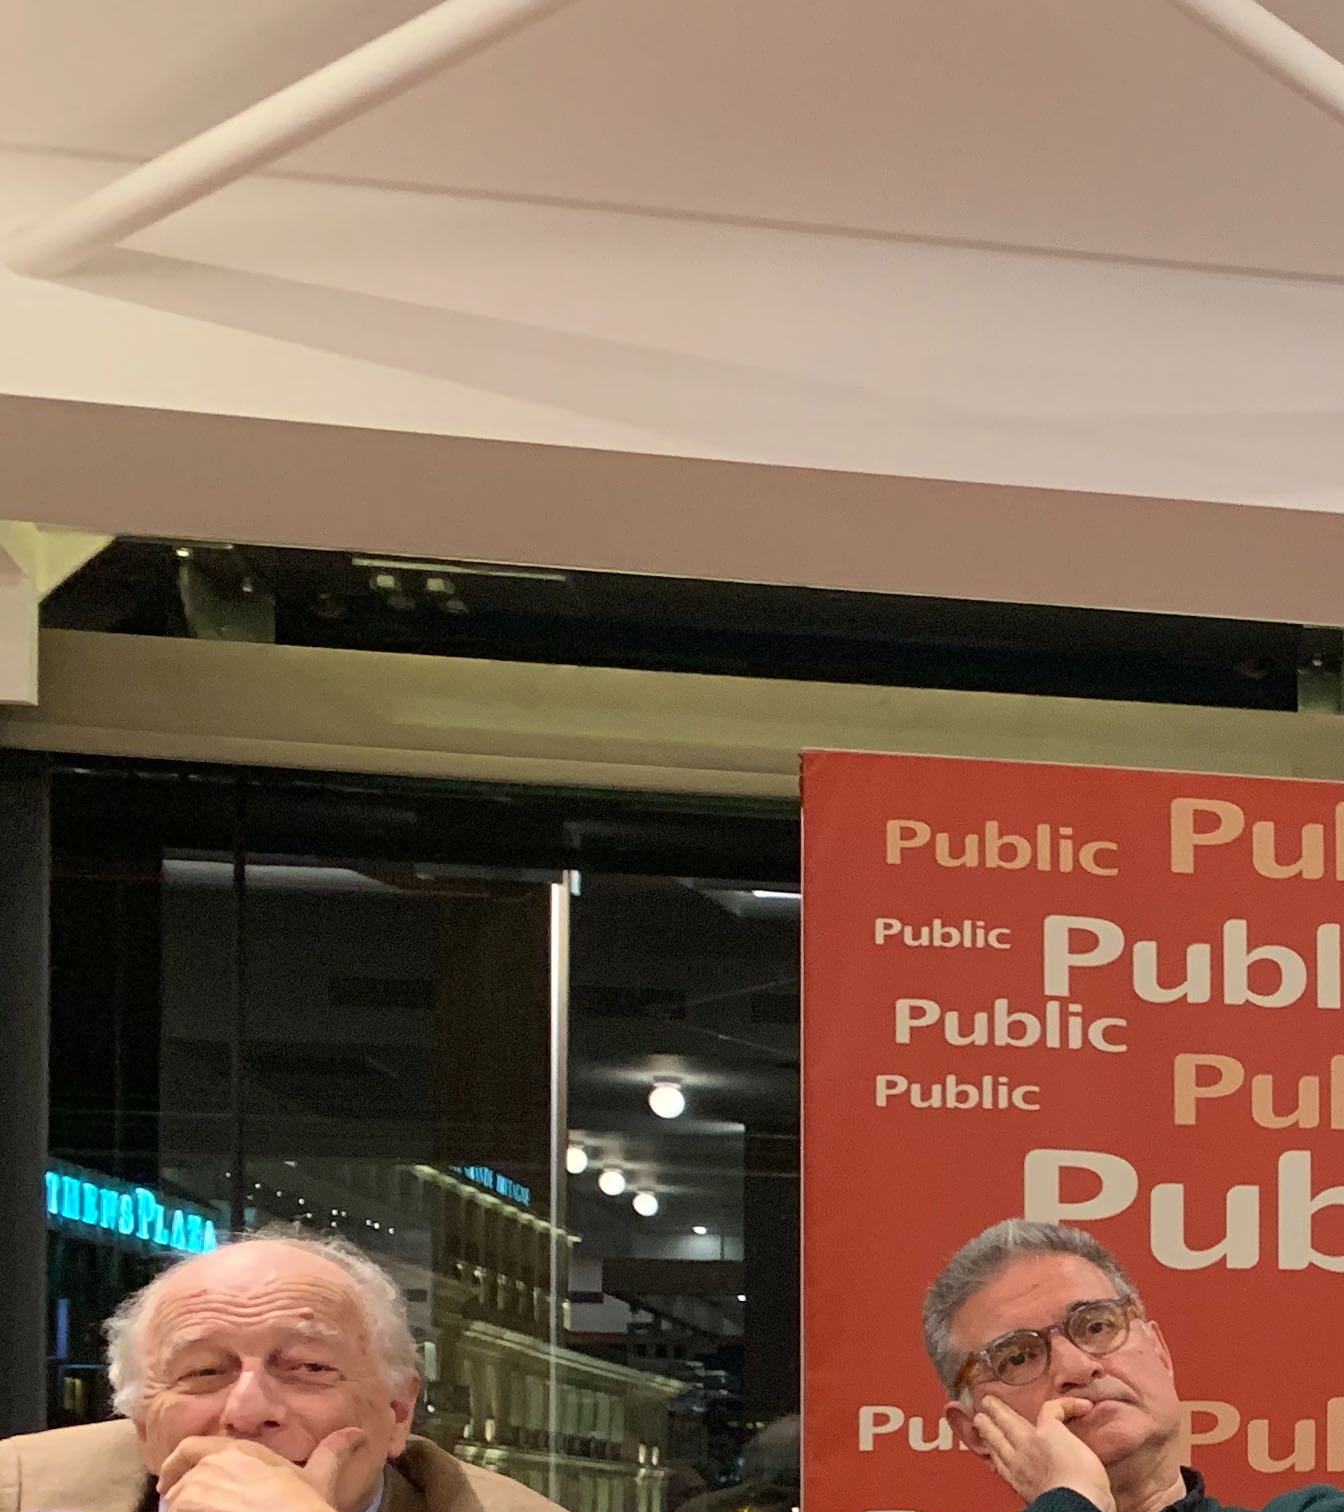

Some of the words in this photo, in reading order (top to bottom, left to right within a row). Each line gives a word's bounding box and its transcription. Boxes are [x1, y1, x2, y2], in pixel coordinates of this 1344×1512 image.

[886, 819, 1119, 876] Public
[874, 917, 1012, 950] Public
[894, 998, 1128, 1053] Public
[875, 1074, 1041, 1111] Public
